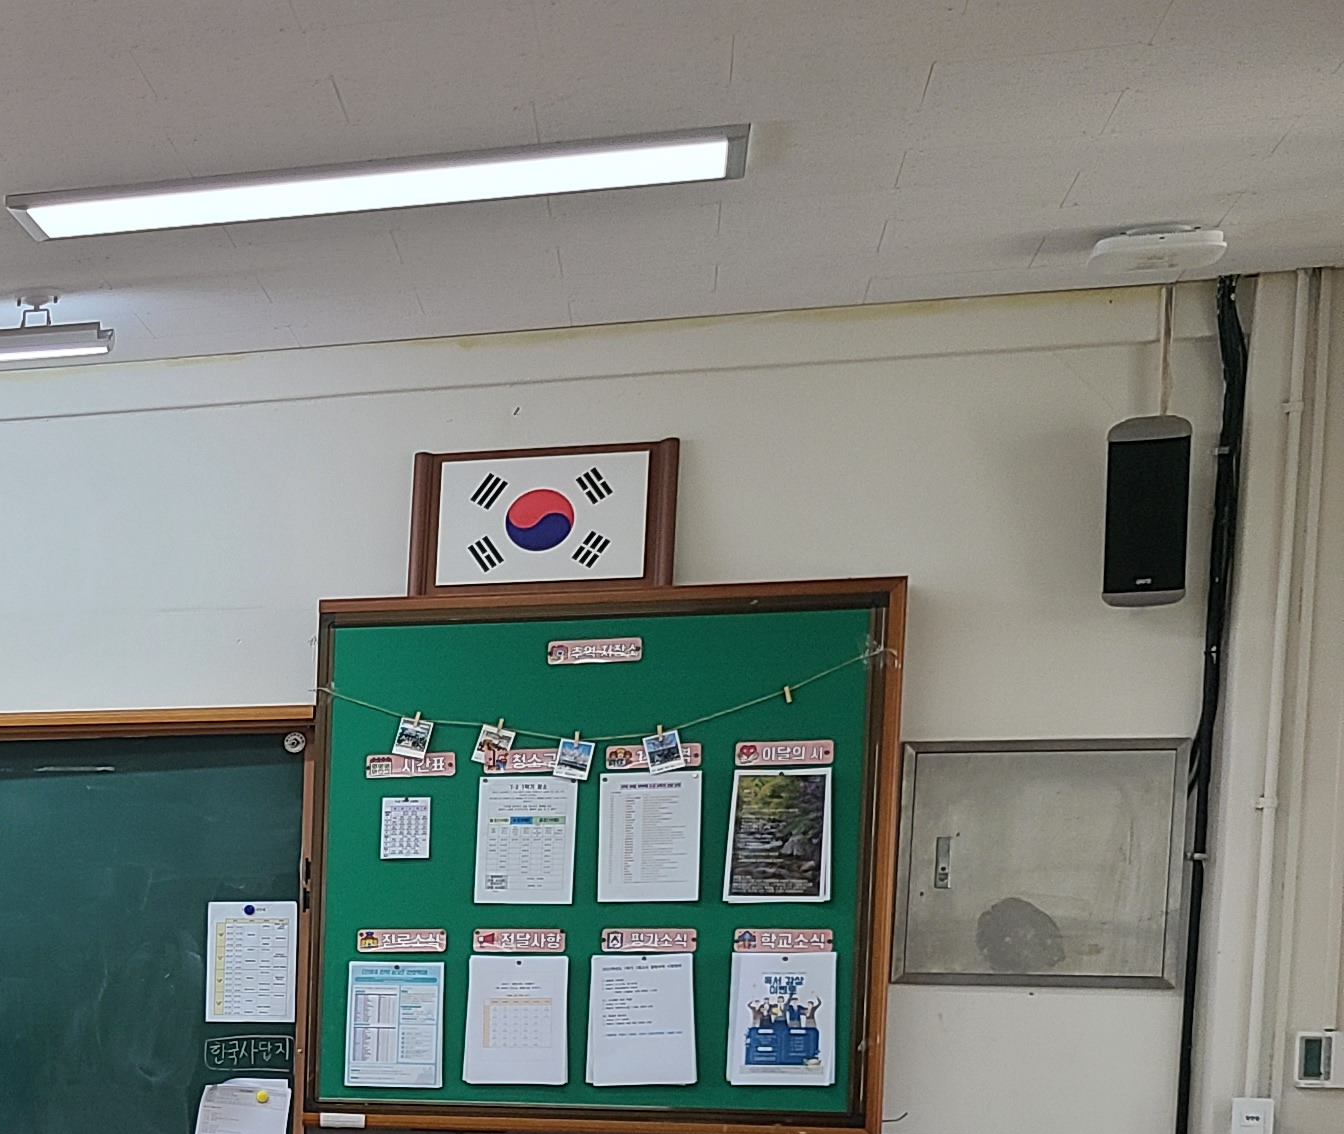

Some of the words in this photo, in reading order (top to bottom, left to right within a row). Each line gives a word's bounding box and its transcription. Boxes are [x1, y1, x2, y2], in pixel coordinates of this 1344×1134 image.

[571, 645, 597, 659] 추억
[601, 643, 638, 657] 저장소
[763, 747, 805, 761] 이달의
[811, 749, 823, 761] 시
[401, 756, 446, 772] 시간표
[382, 934, 441, 949] 진로소식
[501, 933, 561, 948] 전달사항
[631, 933, 688, 947] 평가소식
[761, 933, 825, 949] 학교소식
